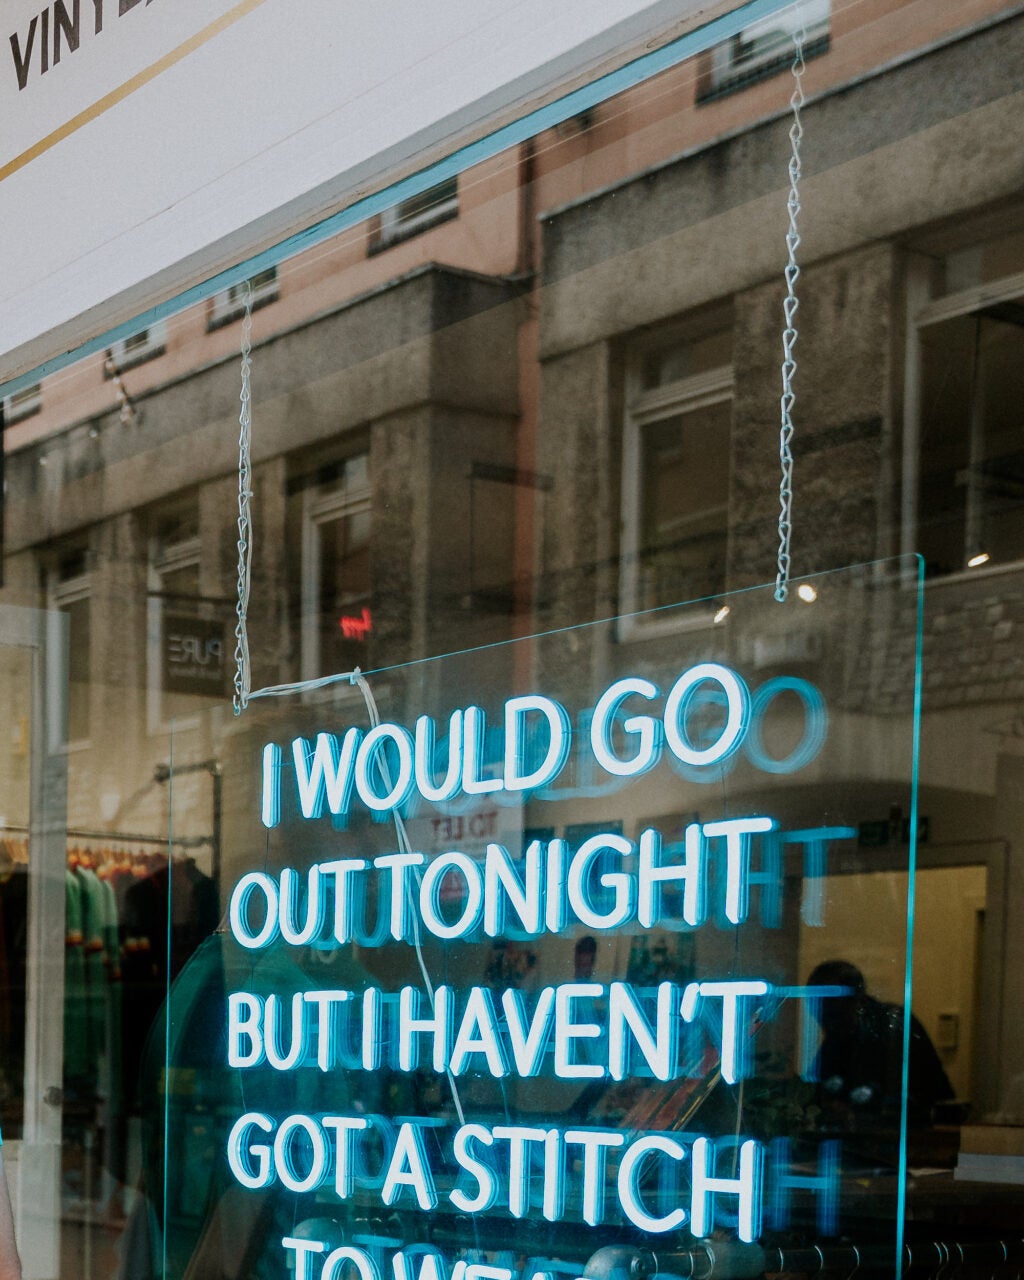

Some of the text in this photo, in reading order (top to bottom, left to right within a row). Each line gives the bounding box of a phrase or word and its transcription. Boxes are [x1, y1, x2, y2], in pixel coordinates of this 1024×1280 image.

[262, 662, 752, 828] I WOULD GO
[230, 817, 775, 948] OUT TONIGHT
[228, 981, 768, 1084] BUT I HAVEN'T
[227, 1112, 763, 1243] GOT A STITCH
